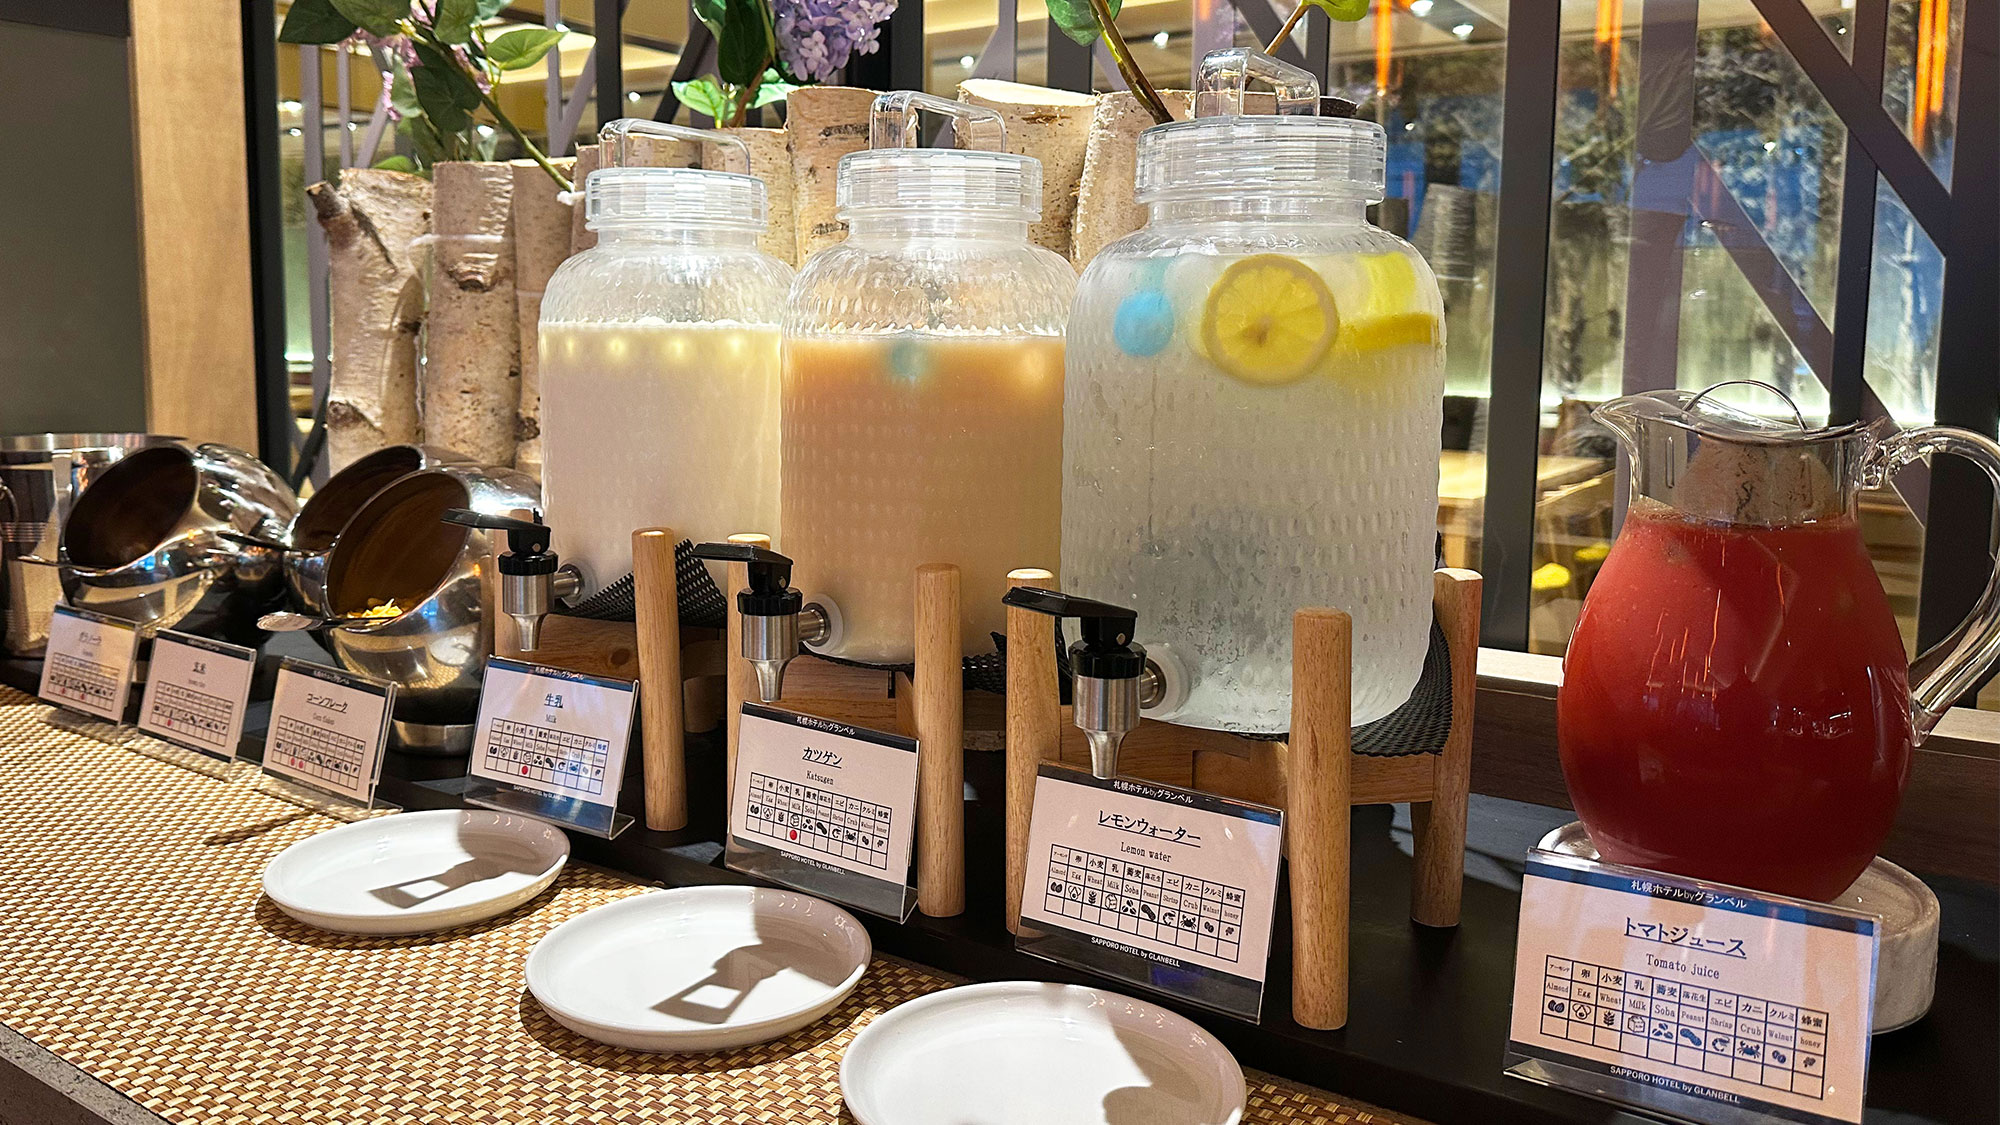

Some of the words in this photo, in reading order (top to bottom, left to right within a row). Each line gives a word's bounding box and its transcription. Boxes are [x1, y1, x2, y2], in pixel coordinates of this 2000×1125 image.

[307, 693, 348, 711] コーンフレーク
[545, 693, 563, 707] 牛乳
[802, 746, 843, 765] カツゲン
[806, 770, 834, 785] Katsugen
[1113, 780, 1193, 804] 札幌ホテルbyグランベル
[1099, 810, 1201, 842] レモンウォーター
[801, 857, 815, 867] HOTEL
[1121, 841, 1145, 857] Lemon
[1149, 850, 1171, 862] water
[1107, 879, 1119, 890] Milk
[1124, 884, 1139, 895] Soba
[1166, 878, 1179, 887] エビ
[1185, 882, 1200, 892] カニ
[1204, 886, 1222, 898] クルミ
[1631, 880, 1747, 909] 札幌ホテルbyグランベル
[1625, 916, 1746, 956] トマトジュース
[1091, 936, 1119, 949] SAPPORO
[1120, 944, 1140, 956] HOTEL
[1140, 950, 1148, 959] by
[1148, 952, 1180, 967] GLANBELL
[1646, 953, 1687, 973] Tomato
[1691, 963, 1720, 980] juice
[1581, 968, 1591, 979] 卵
[1601, 973, 1623, 986] 小麦
[1634, 979, 1645, 991] 乳
[1656, 983, 1678, 998] 蕎麦
[1682, 990, 1706, 1003] 落花生
[1714, 998, 1733, 1008] エビ
[1741, 1002, 1763, 1014] カニ
[1769, 1008, 1795, 1022] クルミ
[1801, 1014, 1823, 1028] 蜂蜜
[1546, 982, 1569, 993] Almond
[1577, 987, 1591, 999] Egg
[1600, 993, 1622, 1005] Wheat
[1628, 998, 1646, 1011] Milk
[1654, 1004, 1675, 1018] Soba
[1680, 1010, 1705, 1023] Peanut
[1710, 1017, 1733, 1030] Shrimp
[1740, 1024, 1762, 1037] Crub
[1768, 1029, 1793, 1042] Walnut
[1800, 1037, 1821, 1049] honey
[1610, 1065, 1650, 1082] SAPPORO
[1652, 1075, 1680, 1089] HOTEL
[1682, 1083, 1692, 1094] by
[1694, 1086, 1741, 1104] GLANBELL
